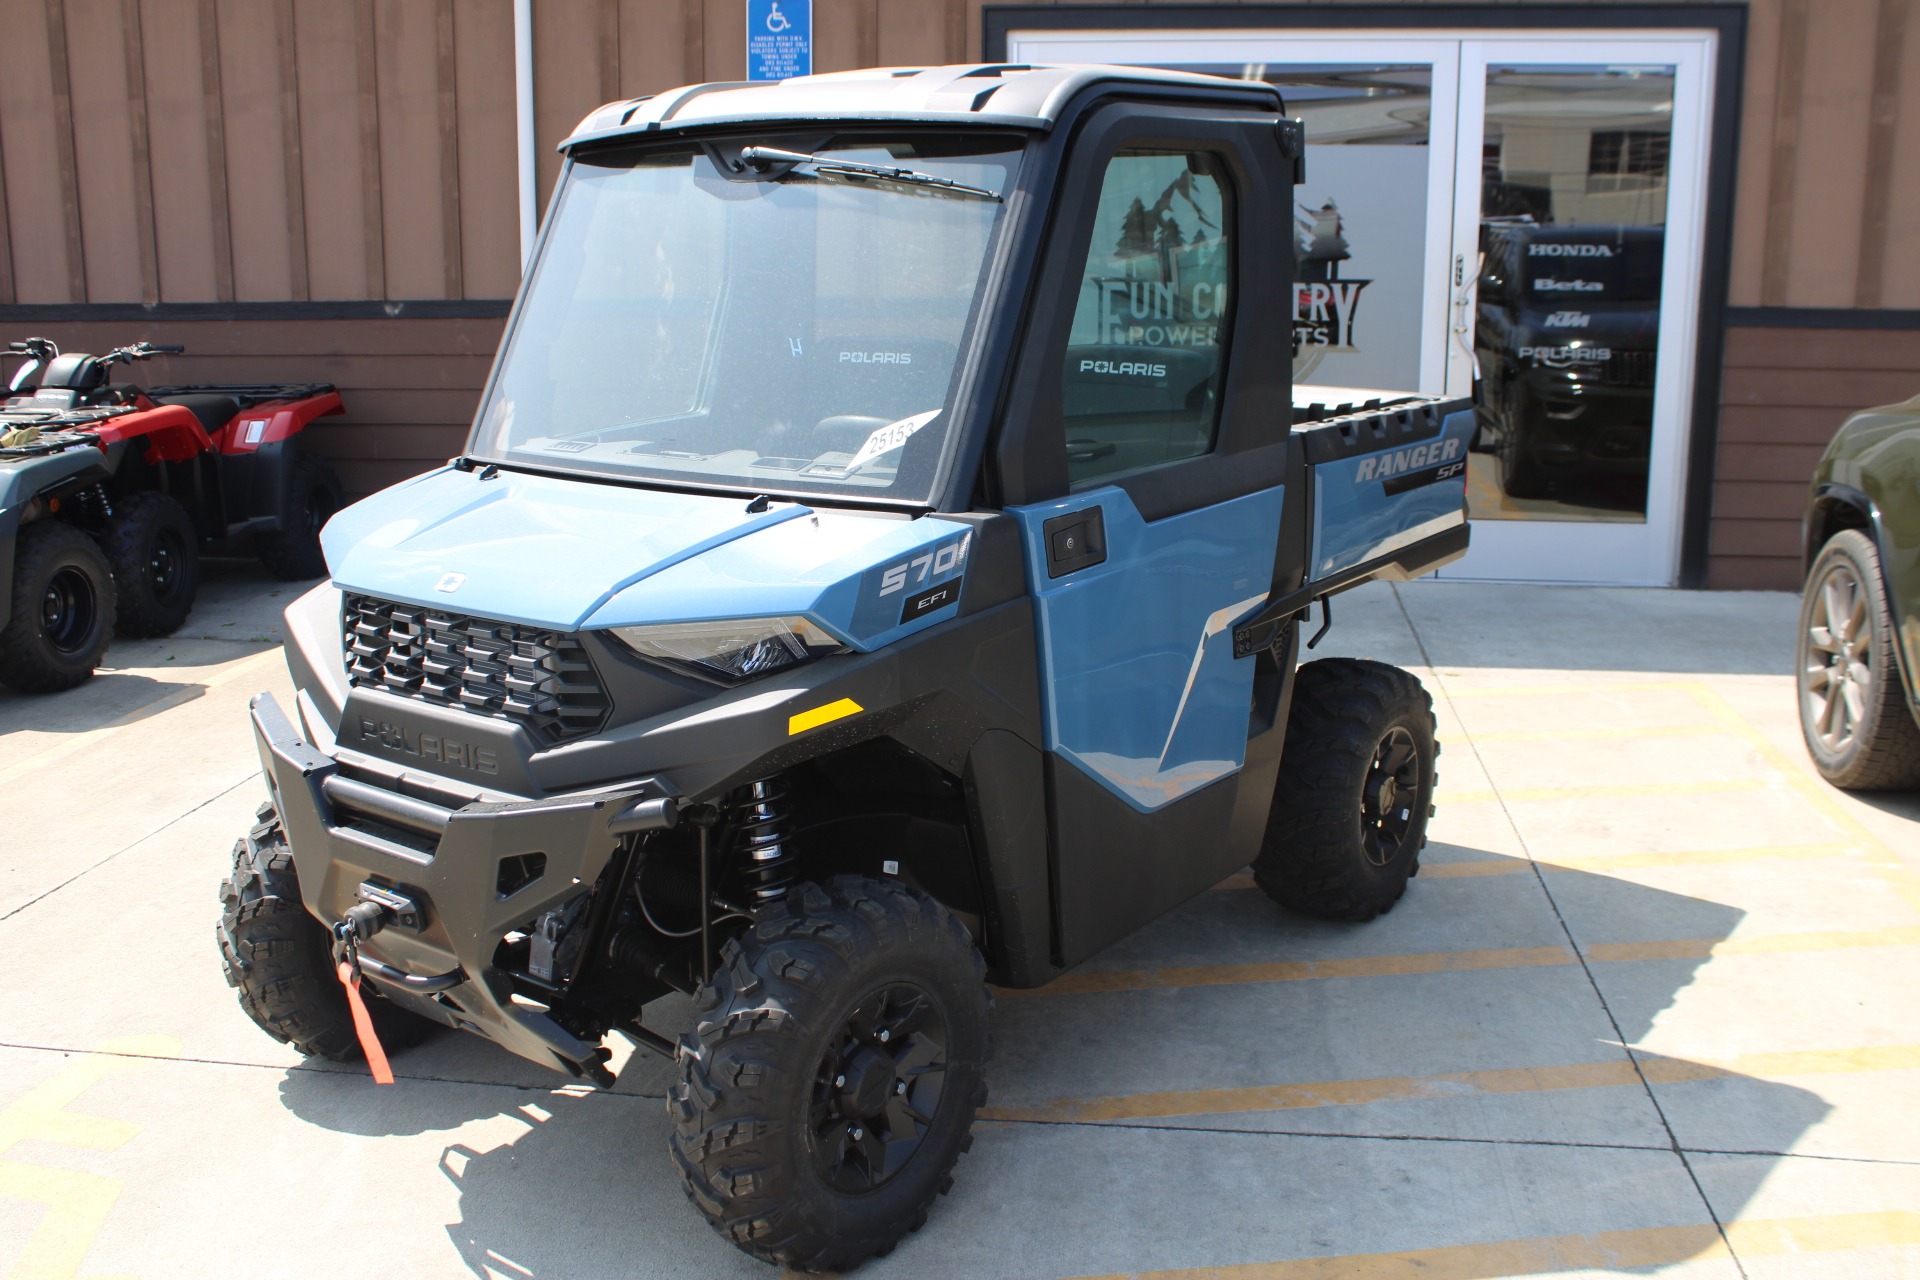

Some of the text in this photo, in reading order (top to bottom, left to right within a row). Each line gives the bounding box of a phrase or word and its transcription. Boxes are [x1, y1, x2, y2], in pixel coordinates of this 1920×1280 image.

[1528, 244, 1613, 257] HONDA
[1533, 278, 1604, 291] Beta
[1101, 281, 1174, 345] FUN
[1544, 311, 1592, 327] KTM
[839, 351, 912, 365] POLARIS
[1518, 347, 1612, 360] POLARIS
[1079, 360, 1167, 378] POLARIS
[869, 421, 915, 455] 25153
[1355, 438, 1460, 483] RANGER
[1436, 462, 1465, 480] SP
[879, 543, 959, 597] 570
[917, 590, 947, 610] EFI
[359, 715, 500, 775] POLARIS
